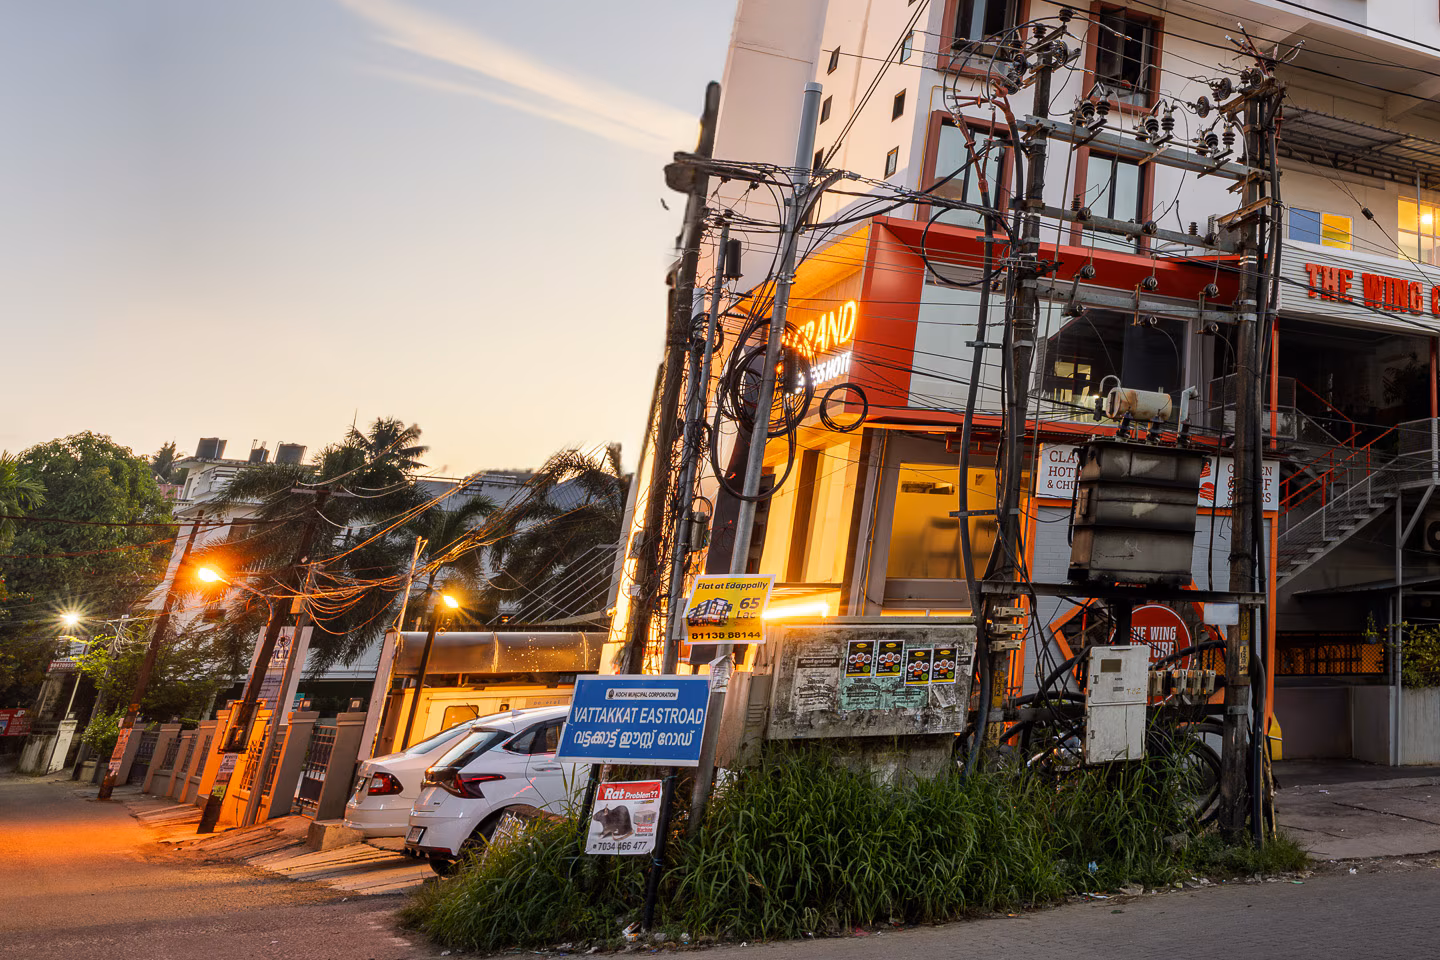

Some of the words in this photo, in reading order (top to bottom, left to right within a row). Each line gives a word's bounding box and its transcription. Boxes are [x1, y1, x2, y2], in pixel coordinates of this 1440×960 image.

[1305, 262, 1353, 302] THE
[1361, 272, 1424, 315] WING
[697, 582, 714, 590] Flat
[725, 581, 769, 591] Edappally
[739, 597, 761, 609] 65
[736, 610, 757, 619] Lac
[691, 631, 725, 640] 81138
[727, 631, 761, 639] 88144
[1150, 626, 1177, 640] WING
[574, 707, 639, 723] VATTAKKAT
[639, 707, 704, 724] EASTROAD
[573, 728, 621, 748] വട്ടക്കാട്ട്
[619, 729, 658, 749] ഈസ്റ്റ്
[657, 730, 696, 747] റോഡ്
[604, 787, 625, 800] Rat
[625, 790, 658, 799] Problem??
[598, 842, 615, 850] 7034
[617, 842, 631, 850] 466
[633, 841, 647, 850] 477
